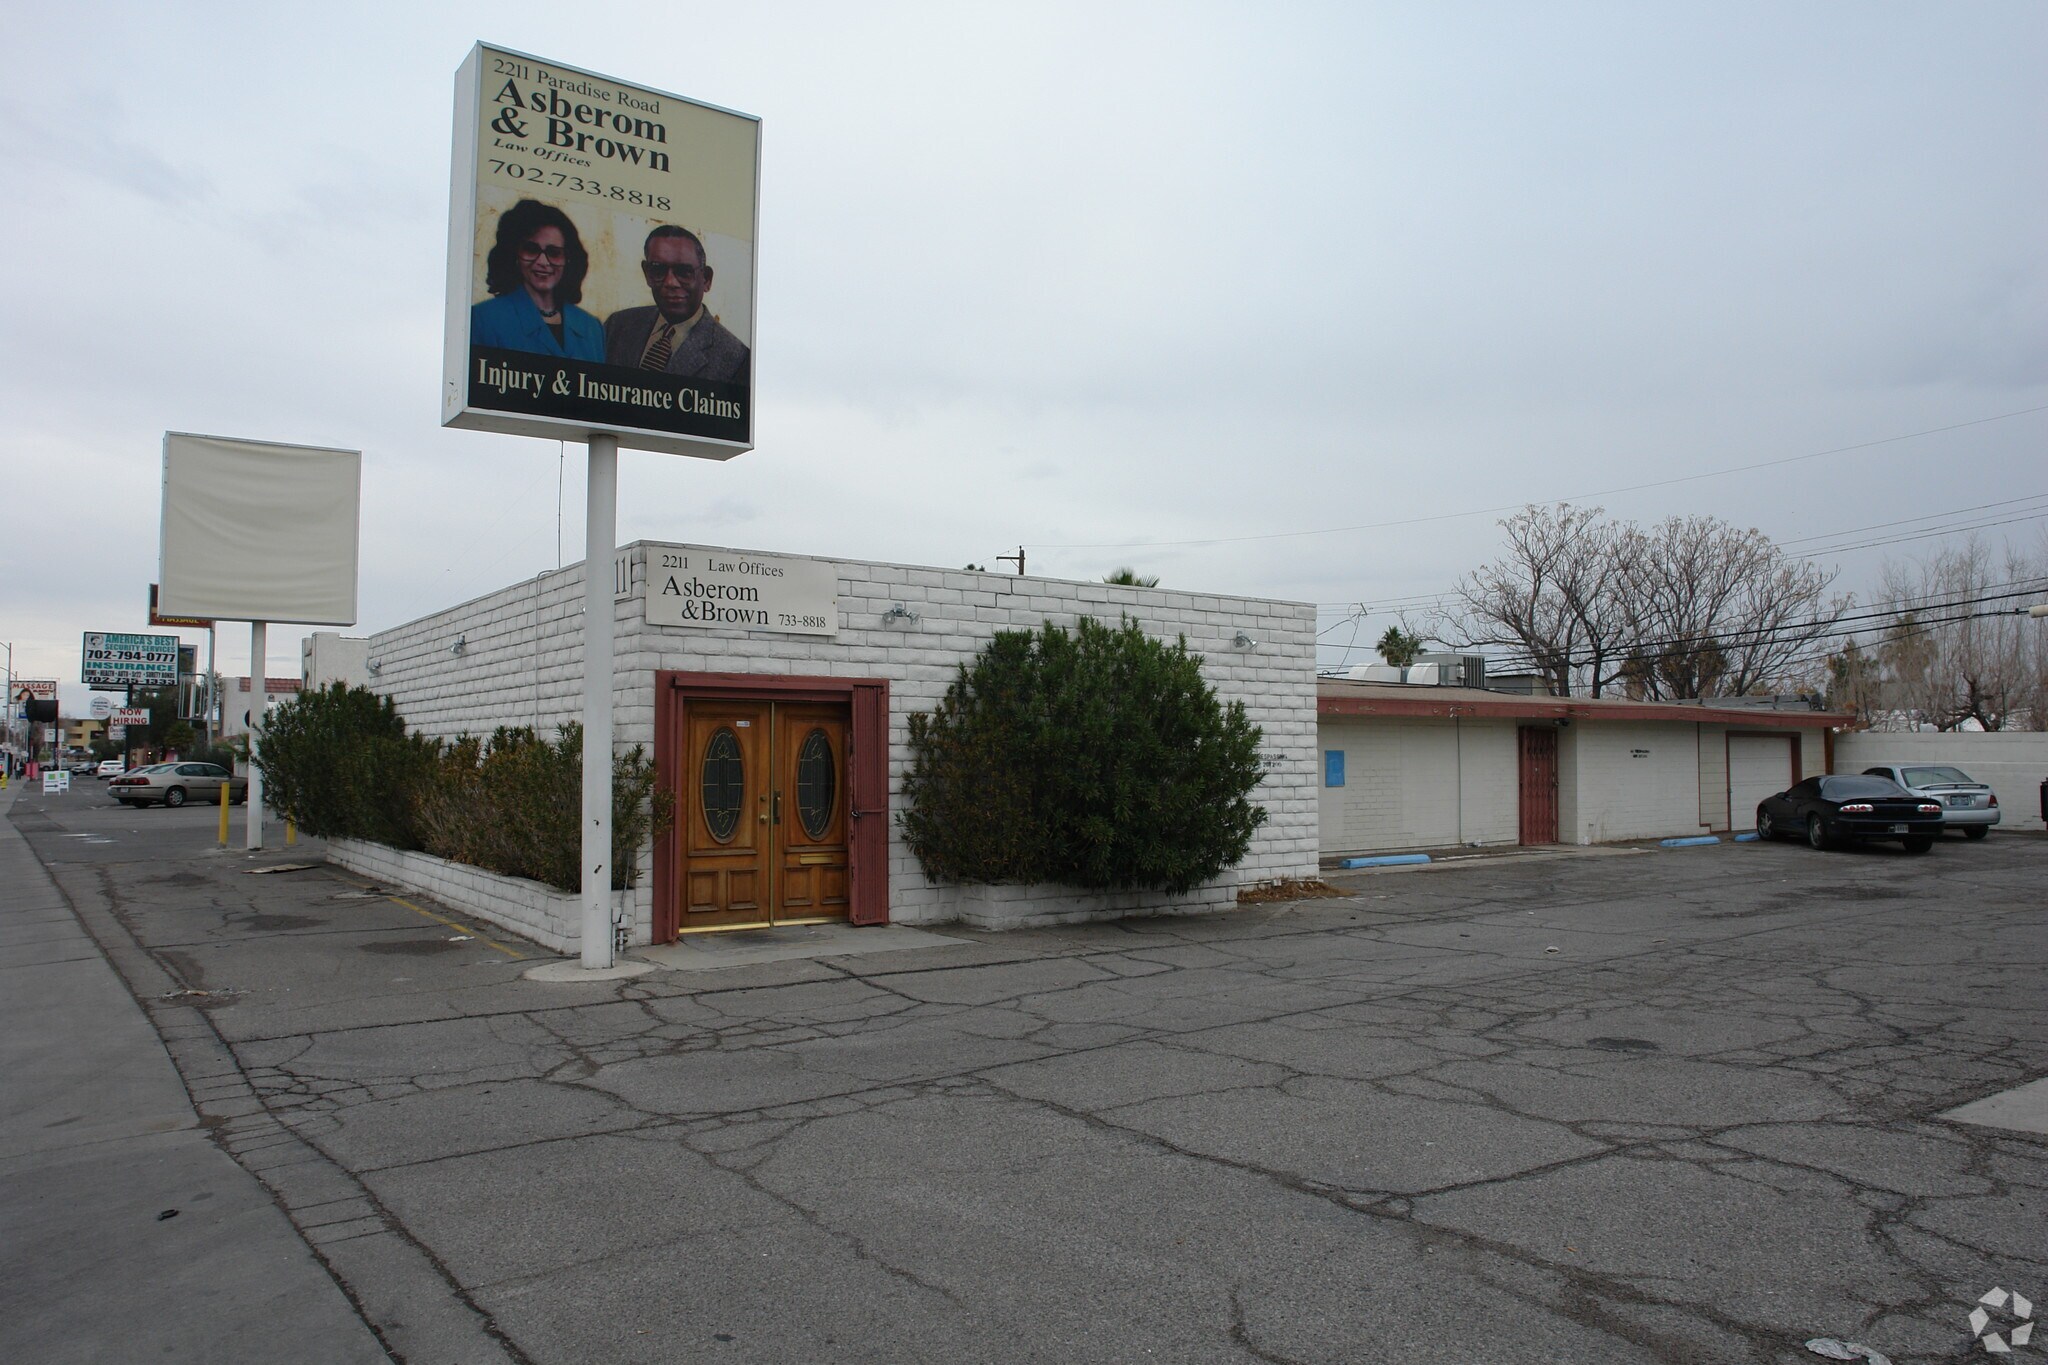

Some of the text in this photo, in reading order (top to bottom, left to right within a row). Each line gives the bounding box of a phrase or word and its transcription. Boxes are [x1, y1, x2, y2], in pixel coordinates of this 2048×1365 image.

[494, 58, 661, 115] 2211 Paradise Road
[492, 78, 668, 145] Asberom
[491, 107, 671, 173] & Brown
[493, 138, 592, 168] Law Offices
[488, 159, 672, 212] 702.733.8818
[478, 358, 742, 419] Injury & Insurance Claims
[662, 555, 784, 578] 2211 Law Offices
[662, 575, 760, 601] Asberom
[778, 613, 826, 628] 733-8818
[105, 634, 176, 646] AMERICA'S BEST
[86, 661, 176, 671] INSURANCE
[87, 650, 176, 662] 702-794-0777
[113, 717, 148, 725] HIRING
